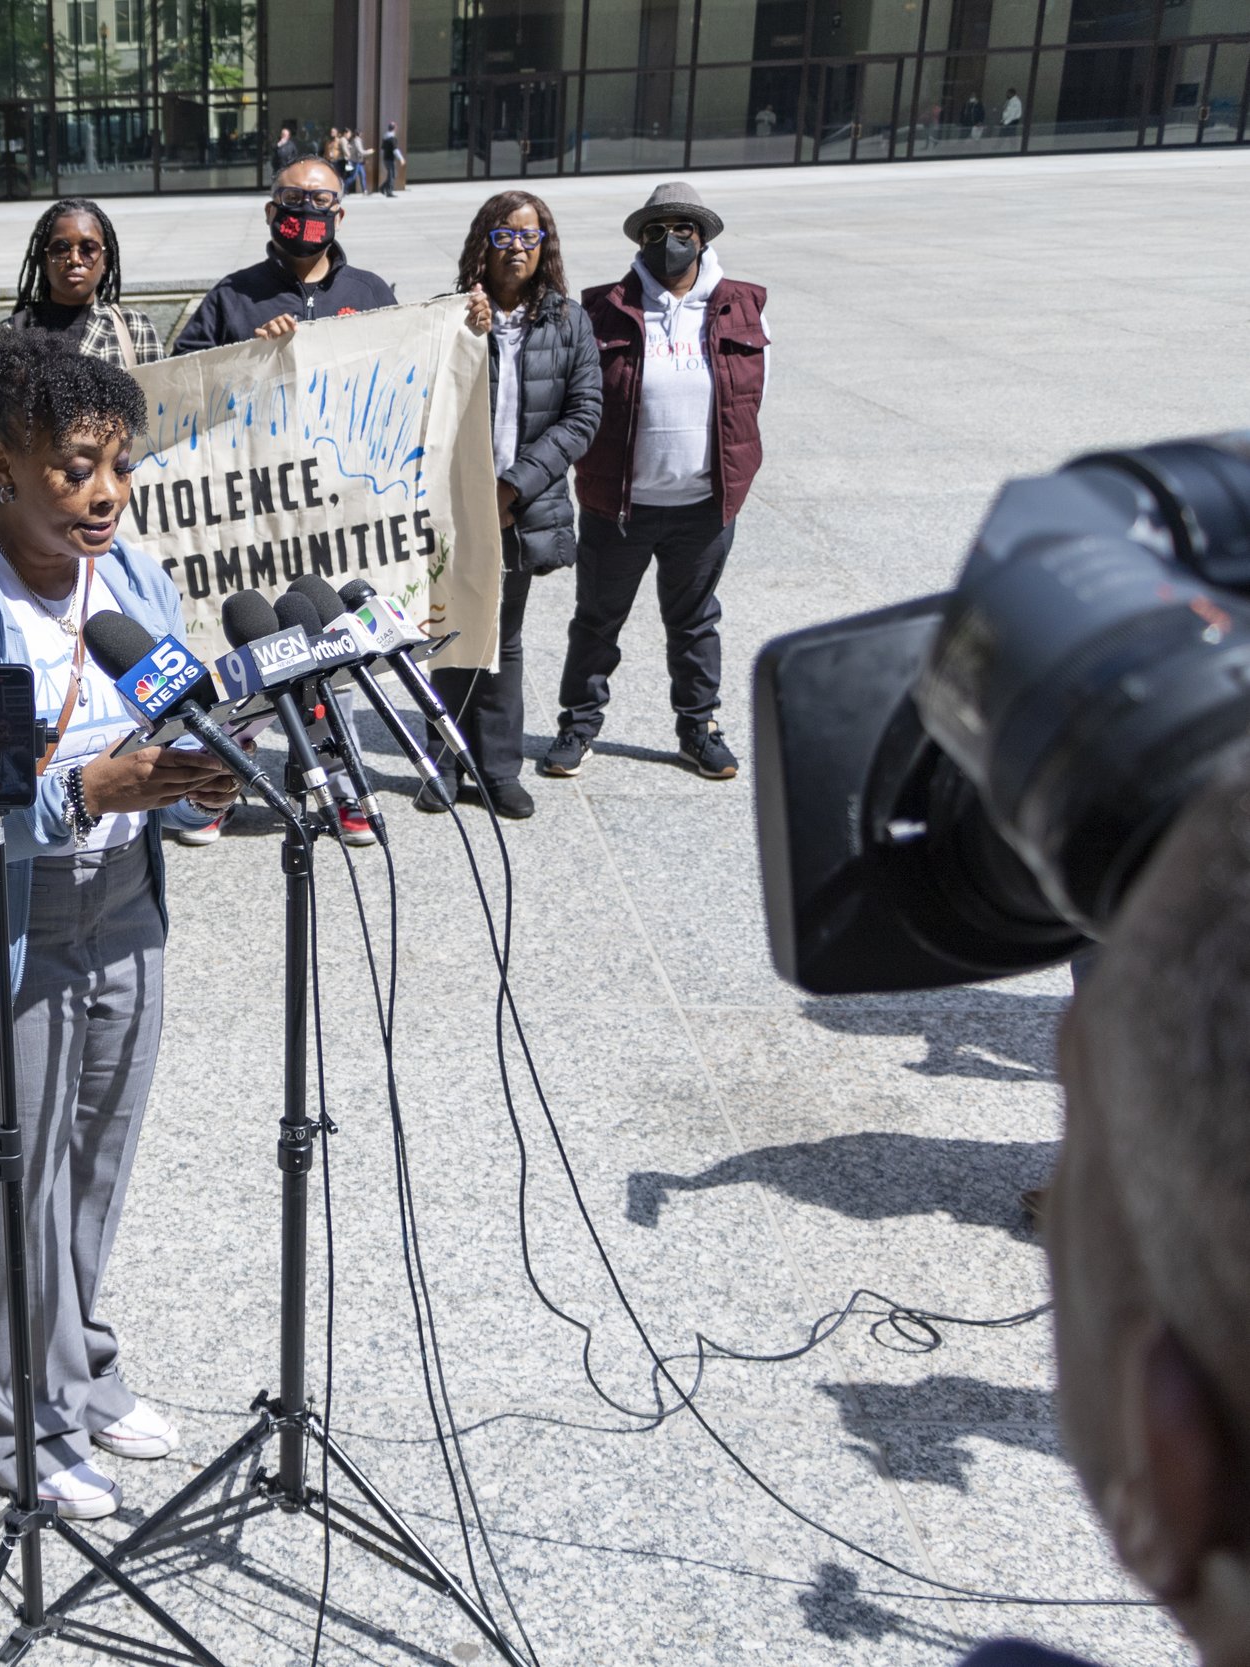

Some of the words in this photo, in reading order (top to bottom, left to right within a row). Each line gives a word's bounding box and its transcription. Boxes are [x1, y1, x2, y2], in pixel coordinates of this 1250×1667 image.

[130, 457, 339, 535] VIOLENCE,
[162, 509, 436, 600] COMMUNITIES
[151, 642, 187, 677] 5
[253, 632, 308, 667] WGN
[376, 628, 394, 645] CIAS
[145, 664, 199, 713] NEWS
[226, 652, 249, 699] 9
